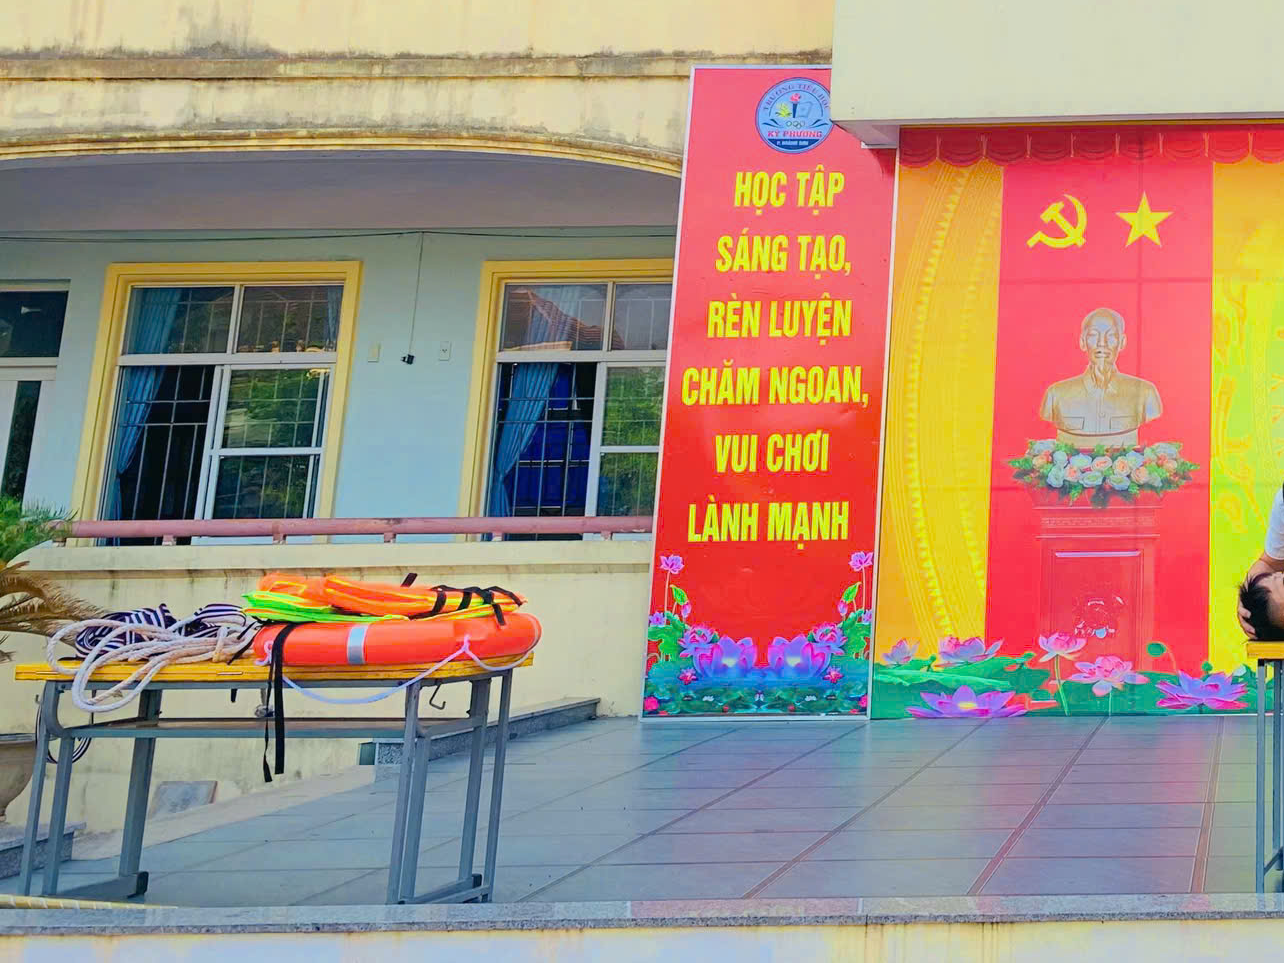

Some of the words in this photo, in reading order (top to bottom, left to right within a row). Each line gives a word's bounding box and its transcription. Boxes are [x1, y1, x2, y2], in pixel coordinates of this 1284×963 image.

[734, 171, 787, 216] HỌC
[796, 164, 845, 216] TẬP
[715, 228, 789, 272] SÁNG
[798, 234, 851, 280] TẠO,
[707, 293, 761, 338] RÈN
[769, 292, 852, 346] LUYỆN
[681, 359, 760, 405] CHĂM
[768, 365, 869, 408] NGOAN,
[715, 434, 758, 472] VUI
[766, 430, 829, 472] CHƠI
[687, 495, 759, 542] LÀNH
[767, 501, 849, 550] MẠNH
